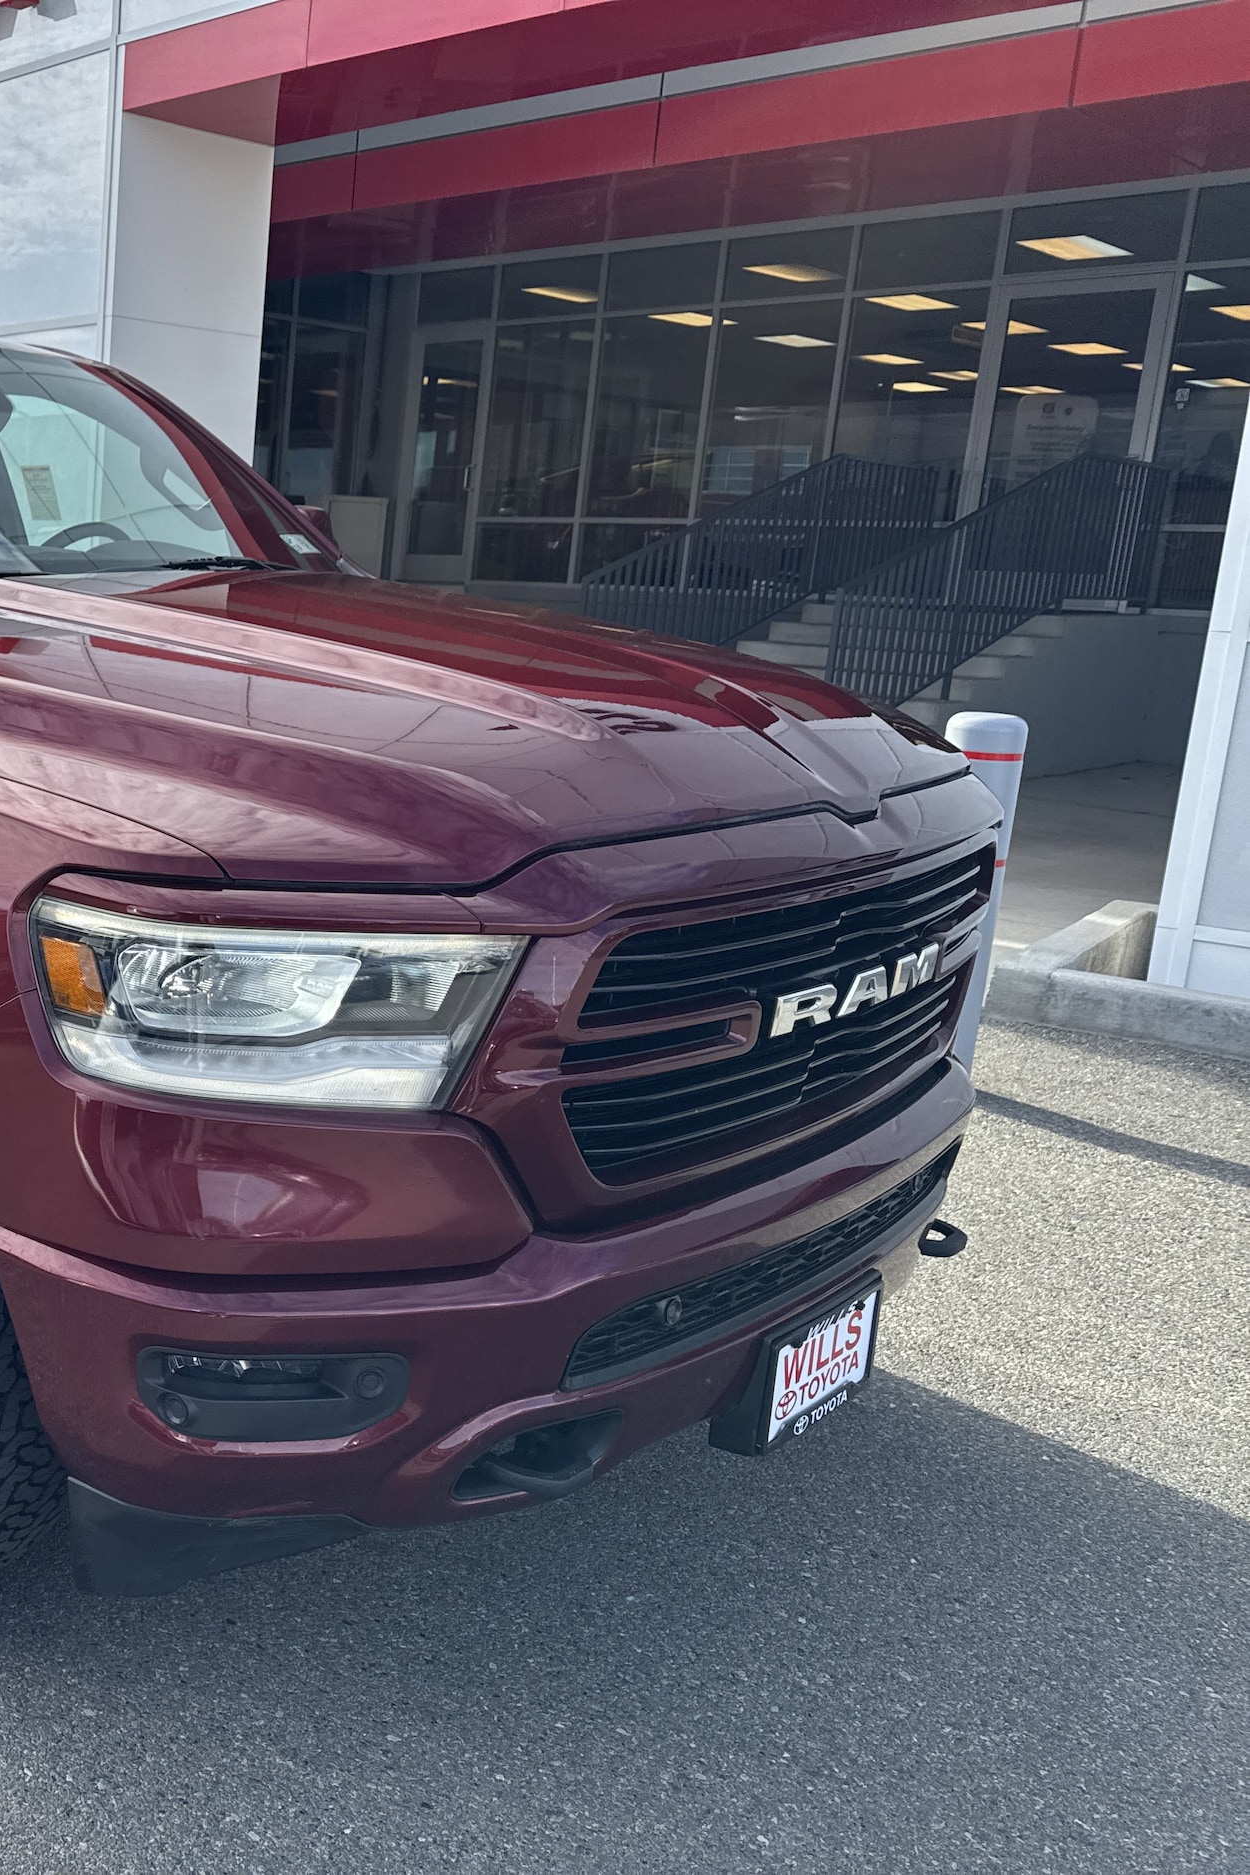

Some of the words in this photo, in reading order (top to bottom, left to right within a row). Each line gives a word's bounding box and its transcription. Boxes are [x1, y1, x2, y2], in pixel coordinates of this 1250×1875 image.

[768, 942, 939, 1039] RAM
[784, 1310, 863, 1390] WILLS
[799, 1350, 859, 1405] TOYOTA
[810, 1389, 848, 1425] TOYOTA
